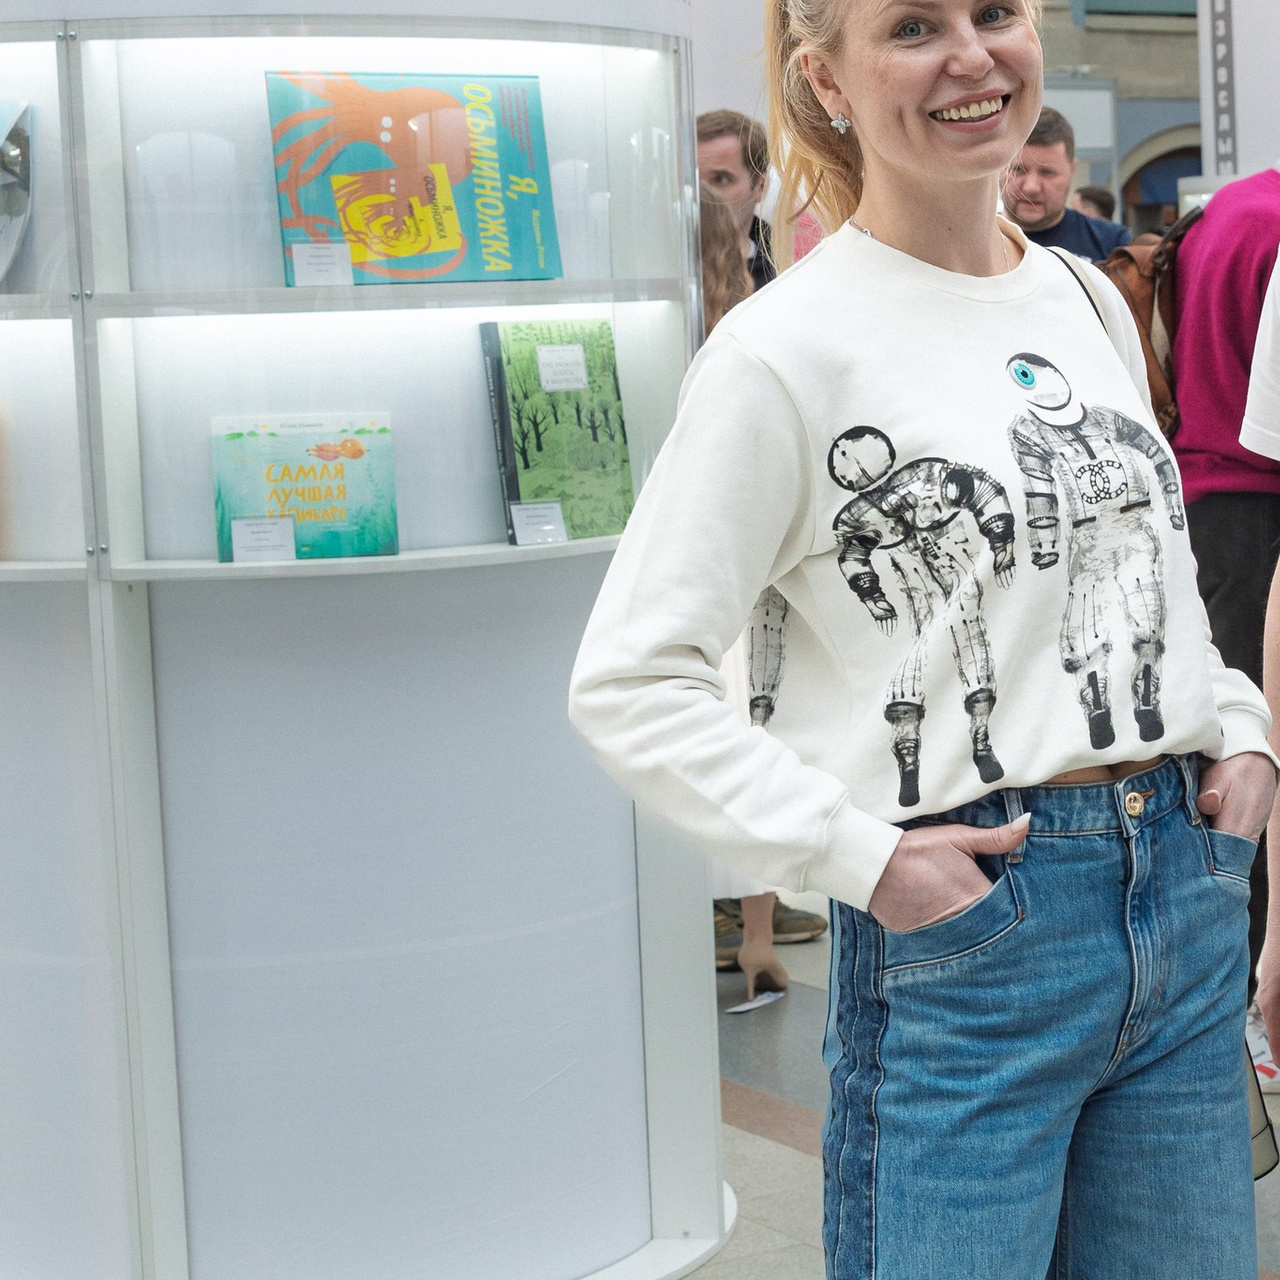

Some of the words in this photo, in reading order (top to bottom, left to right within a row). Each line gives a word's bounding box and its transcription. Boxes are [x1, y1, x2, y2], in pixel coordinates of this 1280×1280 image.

[462, 82, 513, 272] ОСЬМИНОЖКА
[506, 173, 539, 200] Я,
[265, 462, 345, 484] САМАЯ
[266, 484, 347, 508] ЛУЧШАЯ
